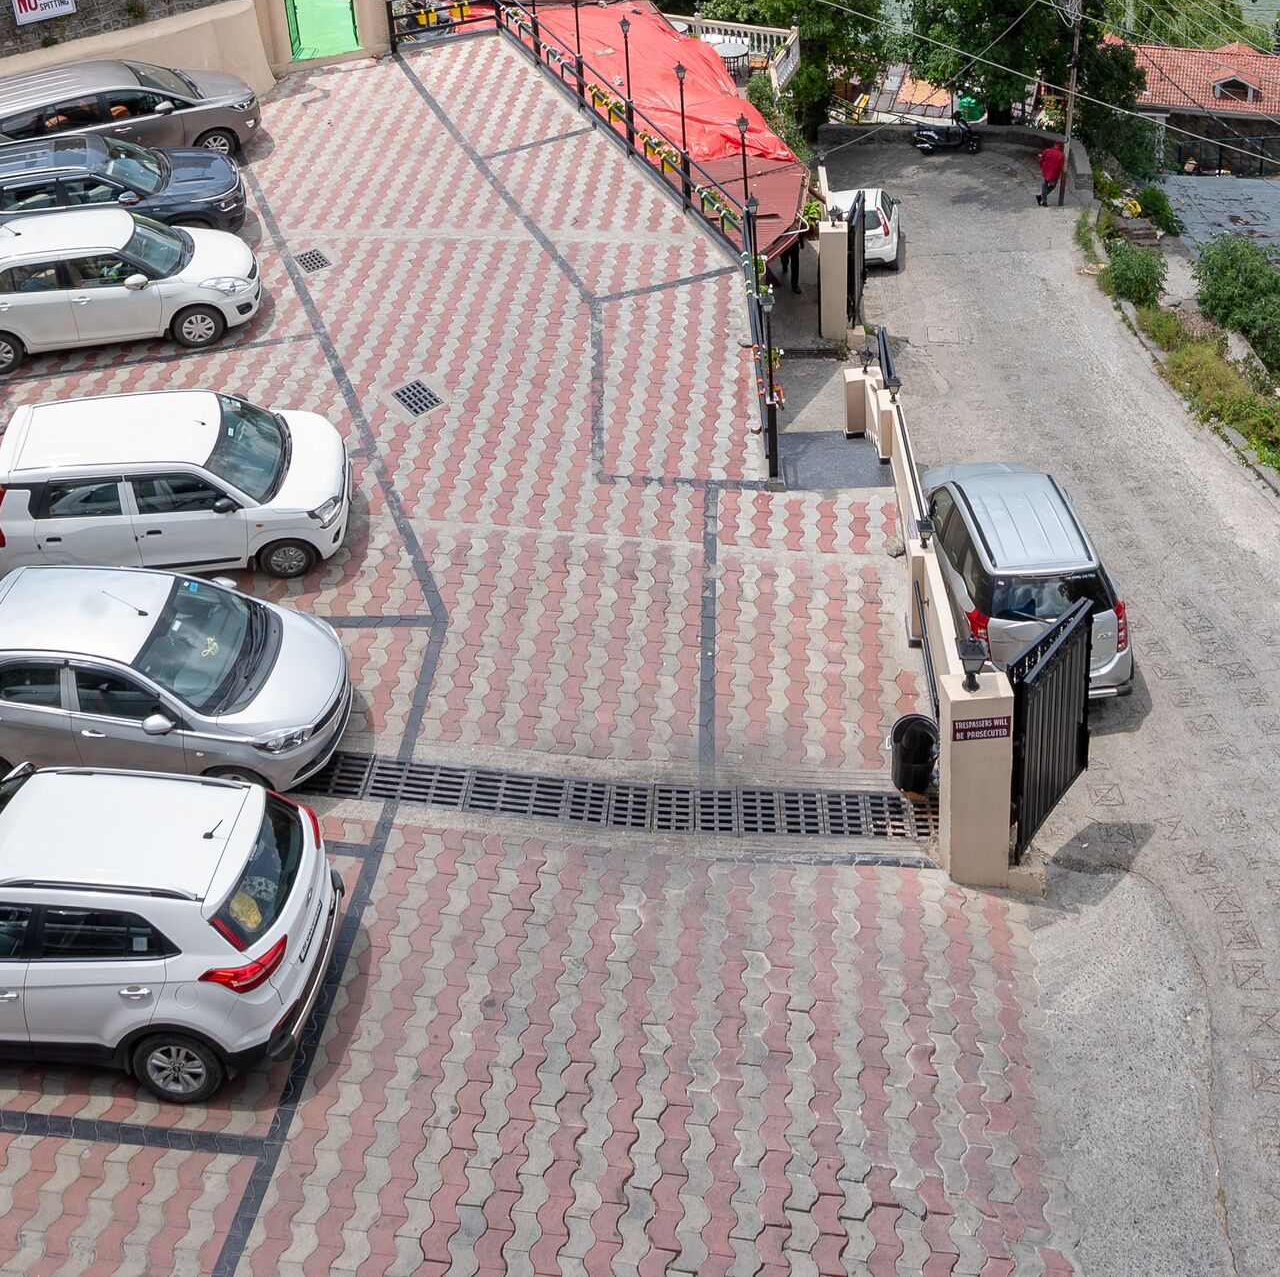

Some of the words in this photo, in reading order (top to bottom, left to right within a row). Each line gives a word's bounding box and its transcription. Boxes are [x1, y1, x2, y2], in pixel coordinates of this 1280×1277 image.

[955, 719, 992, 729] TRESPASSERS
[993, 718, 1008, 726] WILL
[966, 728, 1007, 739] PROSECUTED
